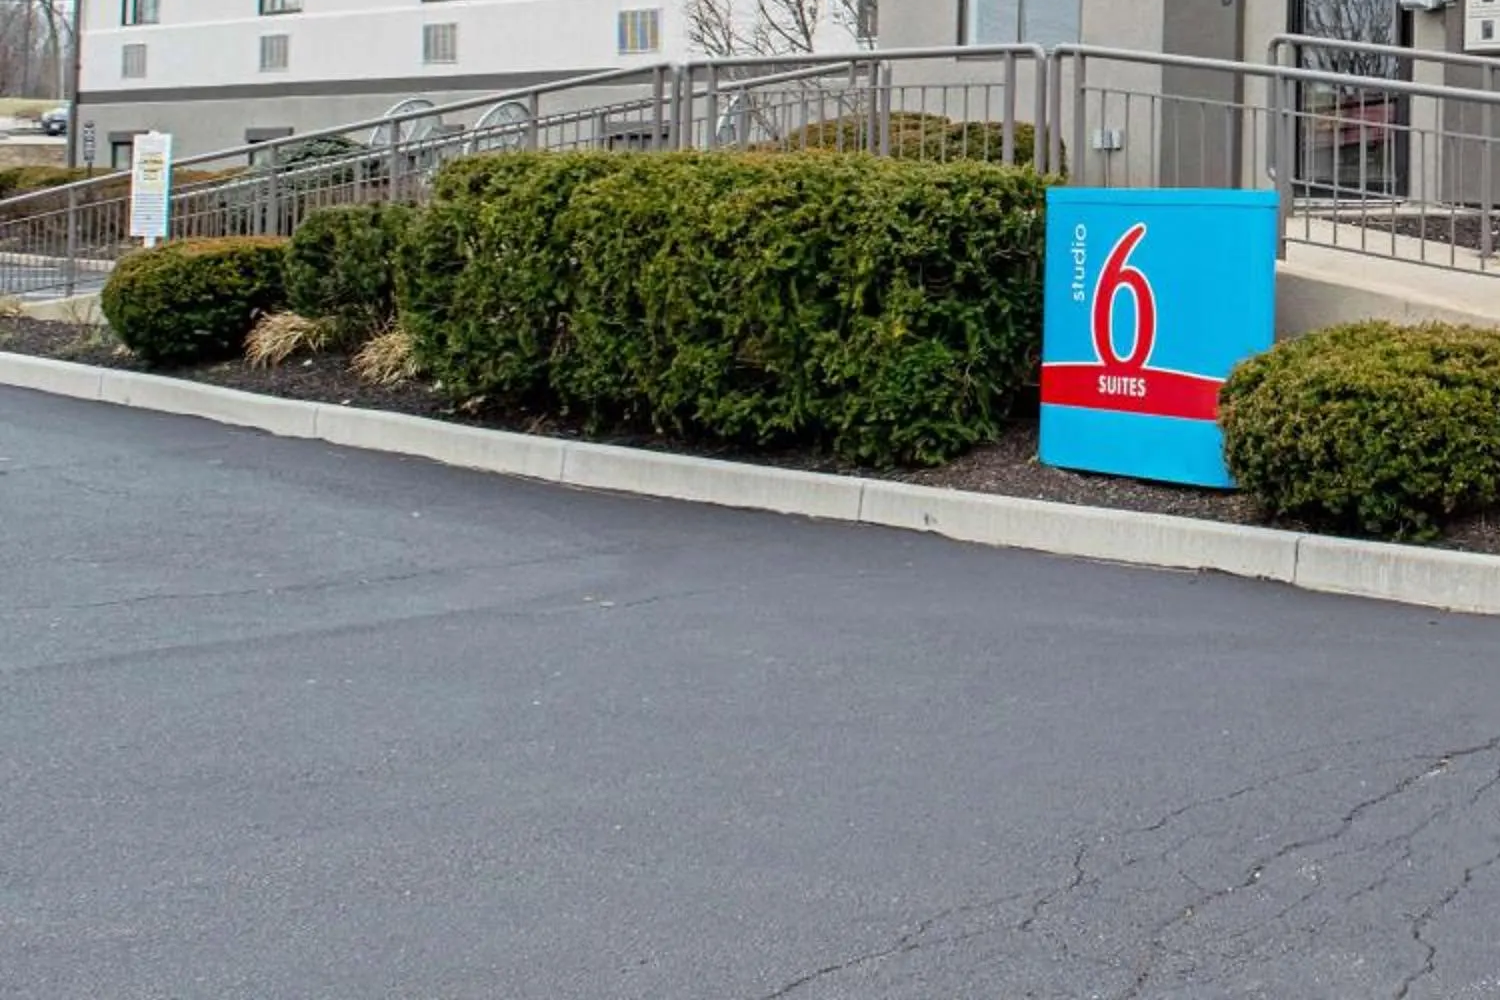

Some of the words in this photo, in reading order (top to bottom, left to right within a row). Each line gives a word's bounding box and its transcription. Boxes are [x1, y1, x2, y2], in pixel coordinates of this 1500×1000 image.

[1071, 223, 1087, 302] studio
[1091, 222, 1157, 369] 6
[1097, 375, 1147, 398] SUITES
